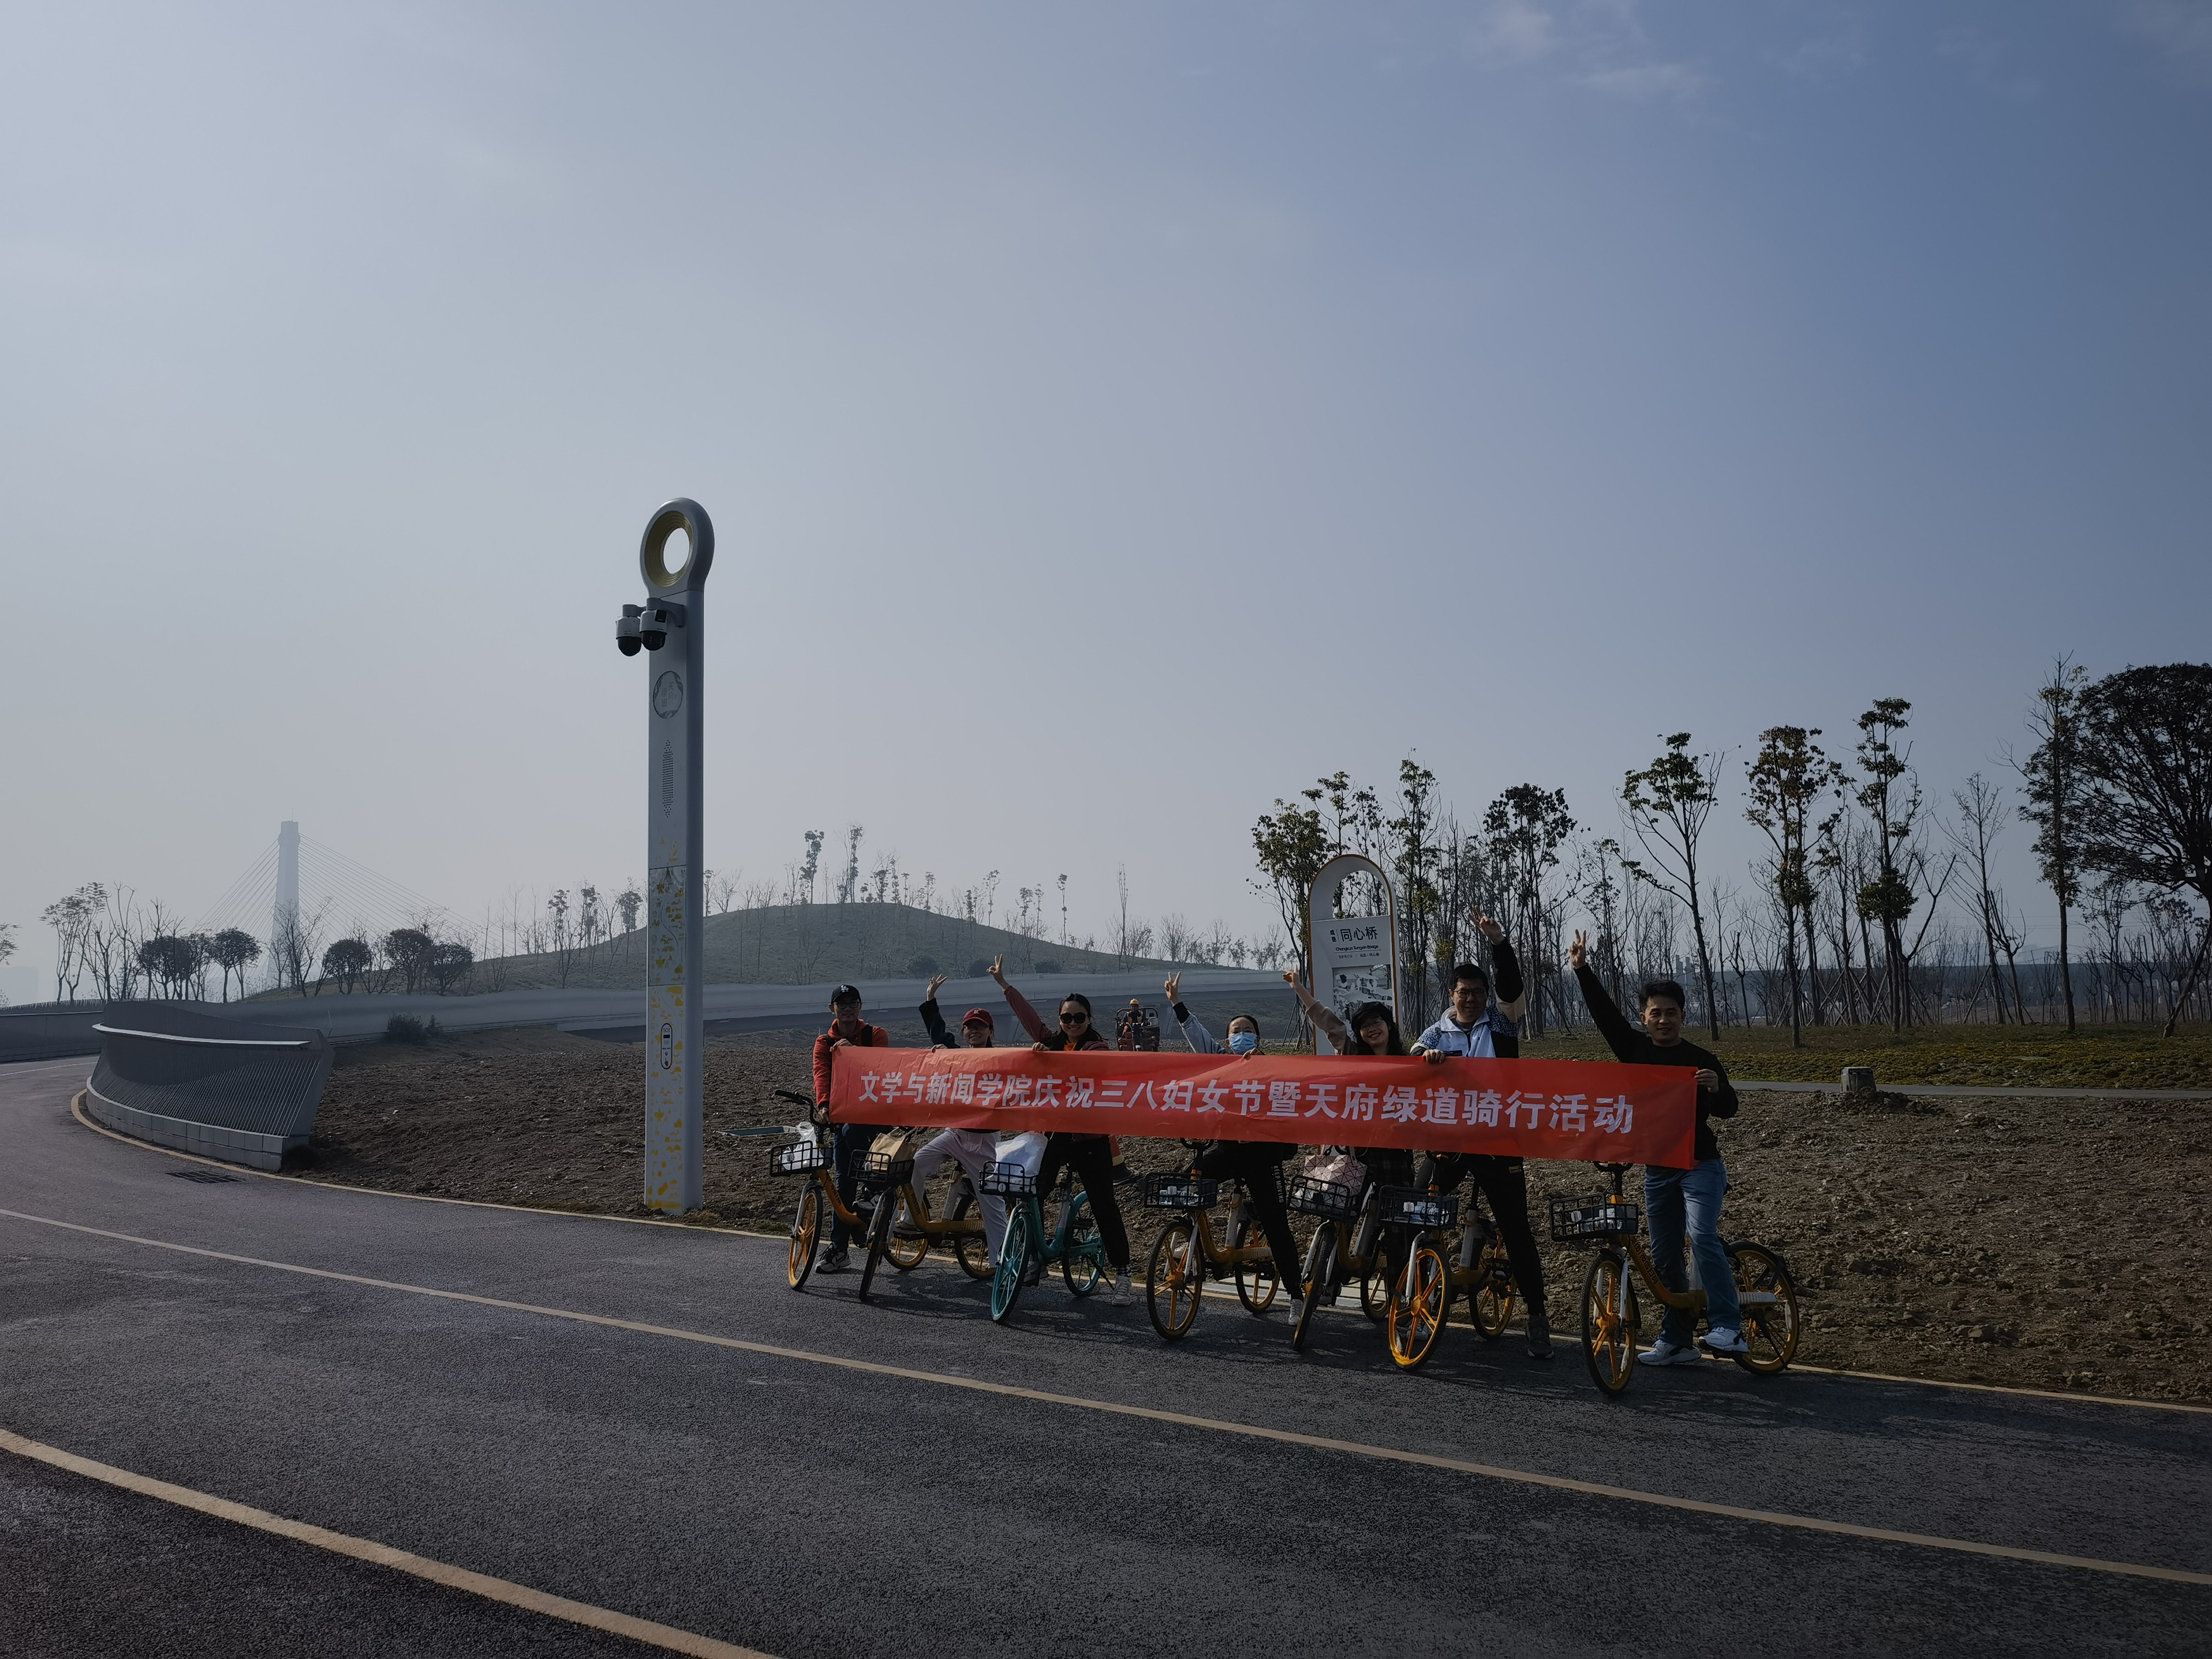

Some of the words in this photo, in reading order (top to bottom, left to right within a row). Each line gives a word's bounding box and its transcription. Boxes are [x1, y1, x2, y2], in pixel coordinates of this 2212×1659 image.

[1340, 926, 1378, 942] 同心桥
[840, 984, 849, 993] LA
[859, 1070, 1634, 1134] 文学与新闻学院庆祝三八妇女节暨天府绿道骑行活动
[1272, 1165, 1280, 1180] KEEP
[1276, 1180, 1284, 1203] MOVING
